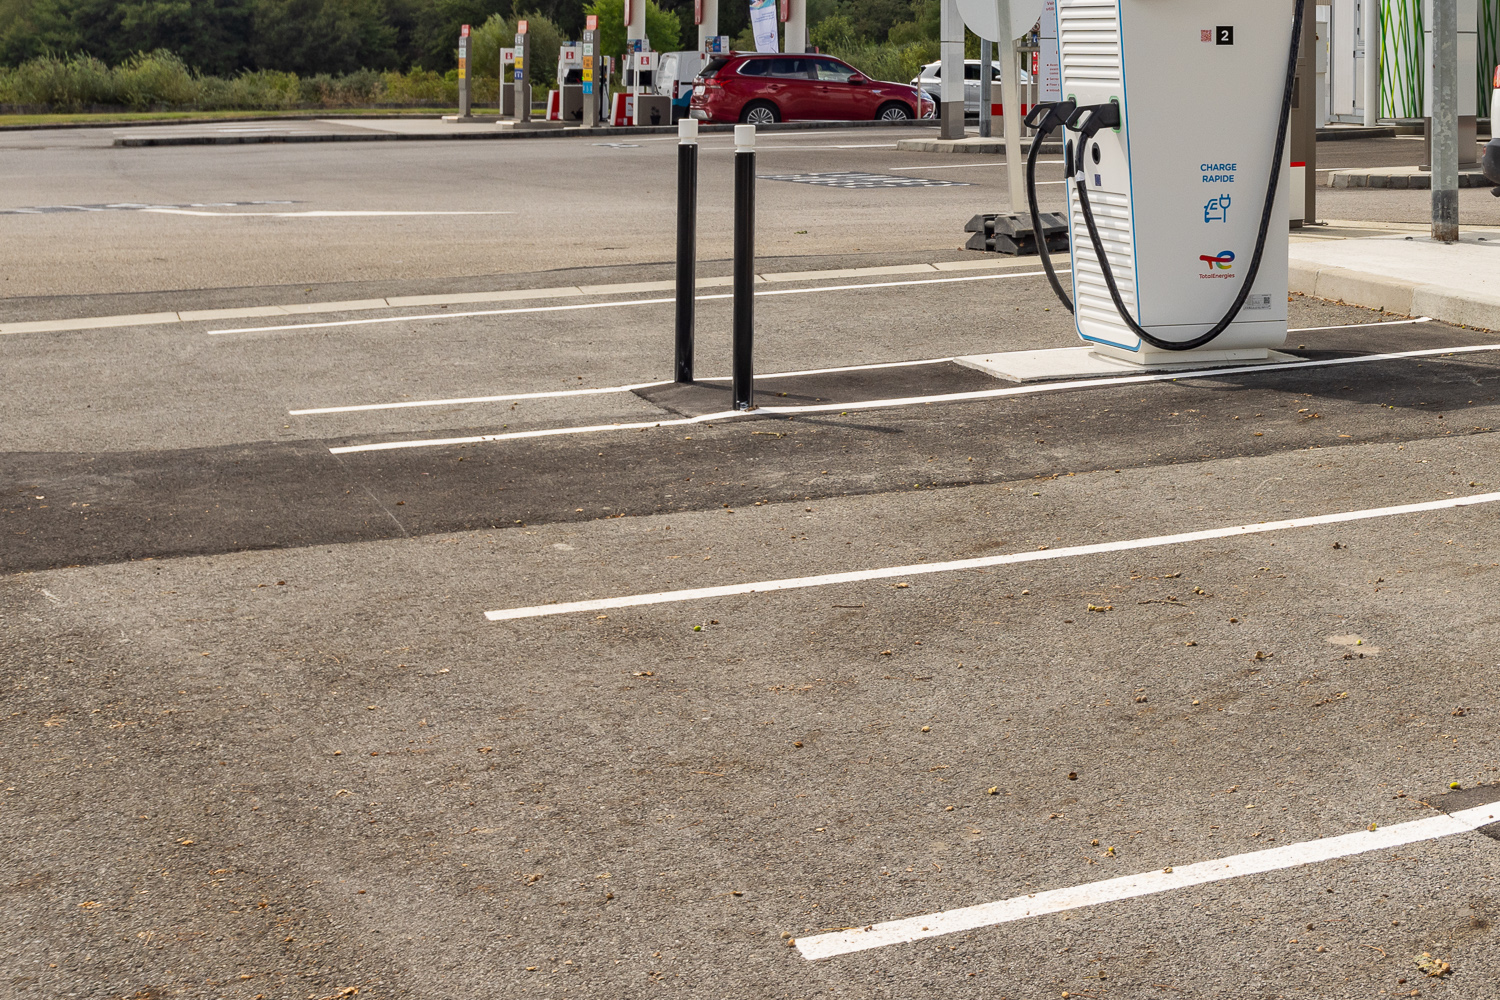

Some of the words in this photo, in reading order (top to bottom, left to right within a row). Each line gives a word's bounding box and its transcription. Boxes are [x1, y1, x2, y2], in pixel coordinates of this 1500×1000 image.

[1221, 30, 1229, 41] 2
[1200, 163, 1237, 171] CHARGE
[1202, 174, 1235, 183] RAPIDE
